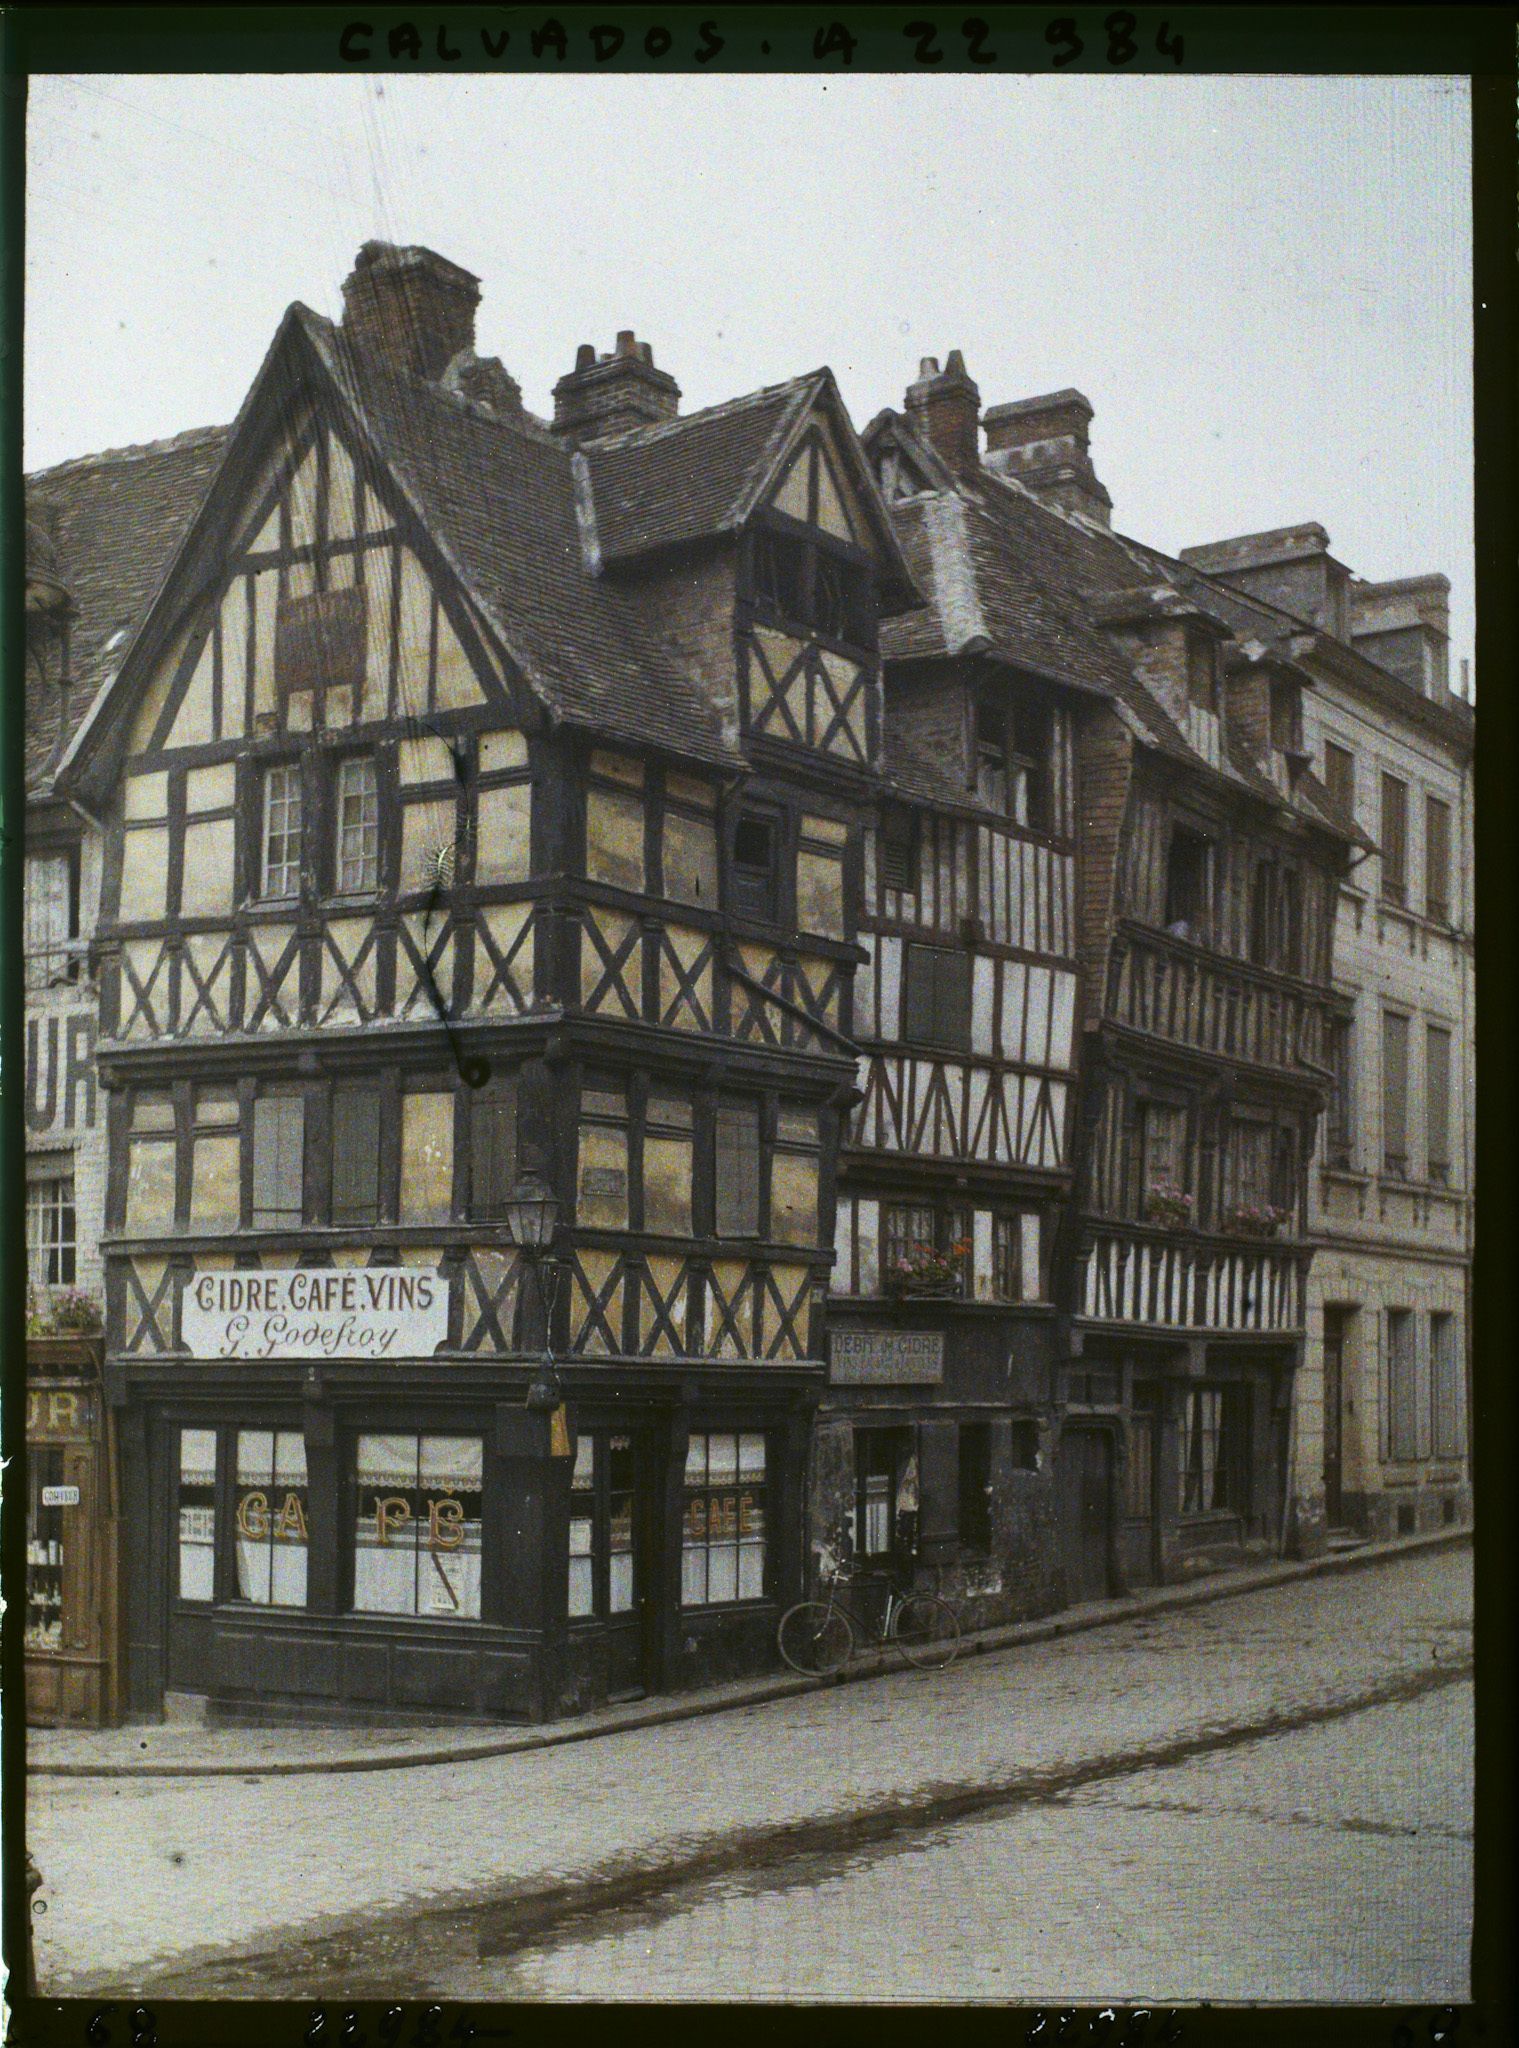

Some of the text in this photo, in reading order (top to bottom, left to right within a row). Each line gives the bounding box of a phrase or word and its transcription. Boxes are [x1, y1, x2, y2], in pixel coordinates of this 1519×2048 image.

[812, 21, 858, 65] A
[902, 18, 998, 64] 22
[363, 1274, 434, 1312] VINS
[257, 1313, 401, 1357] Godefroy
